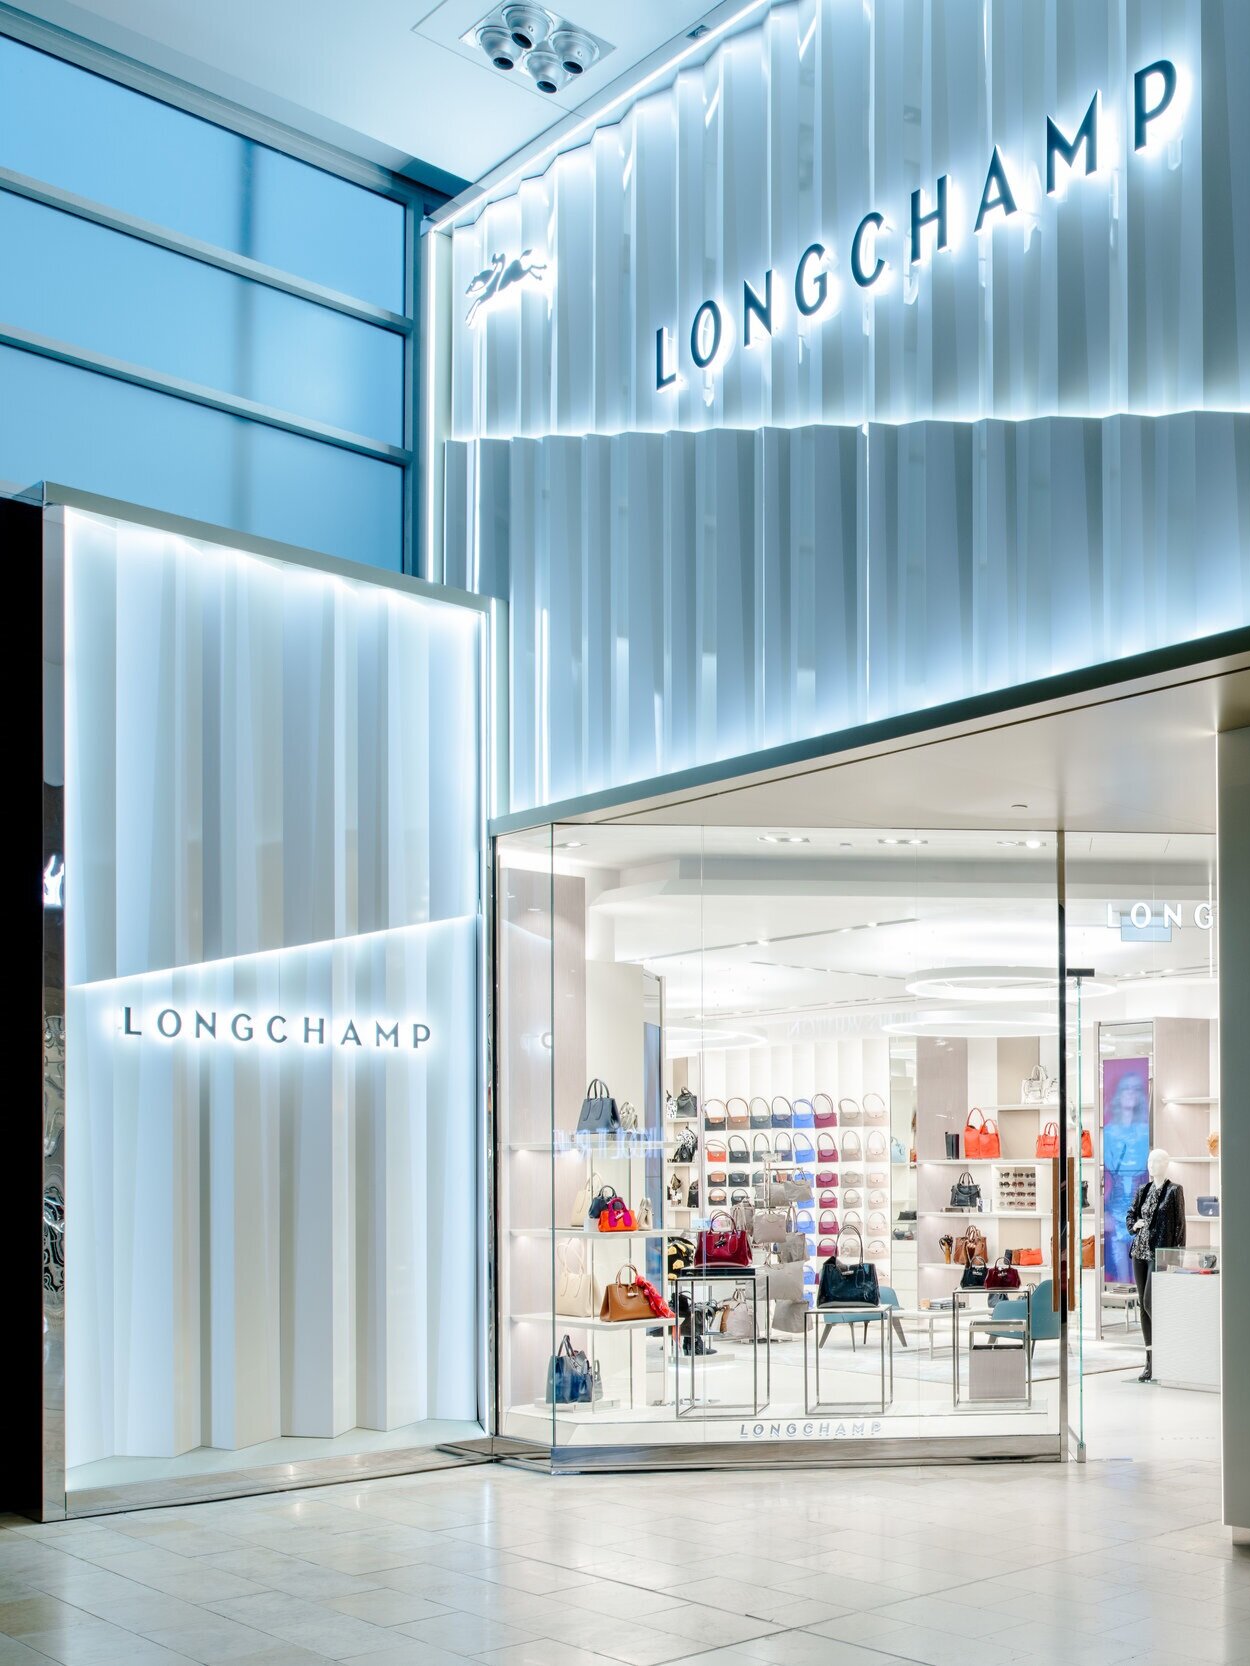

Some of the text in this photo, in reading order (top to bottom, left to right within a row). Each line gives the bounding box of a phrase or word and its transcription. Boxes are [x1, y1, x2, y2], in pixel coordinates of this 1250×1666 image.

[655, 59, 1178, 392] LONGCHAMP
[121, 1006, 431, 1049] LONGCHAMP
[740, 1421, 882, 1438] LONGCHAMP
